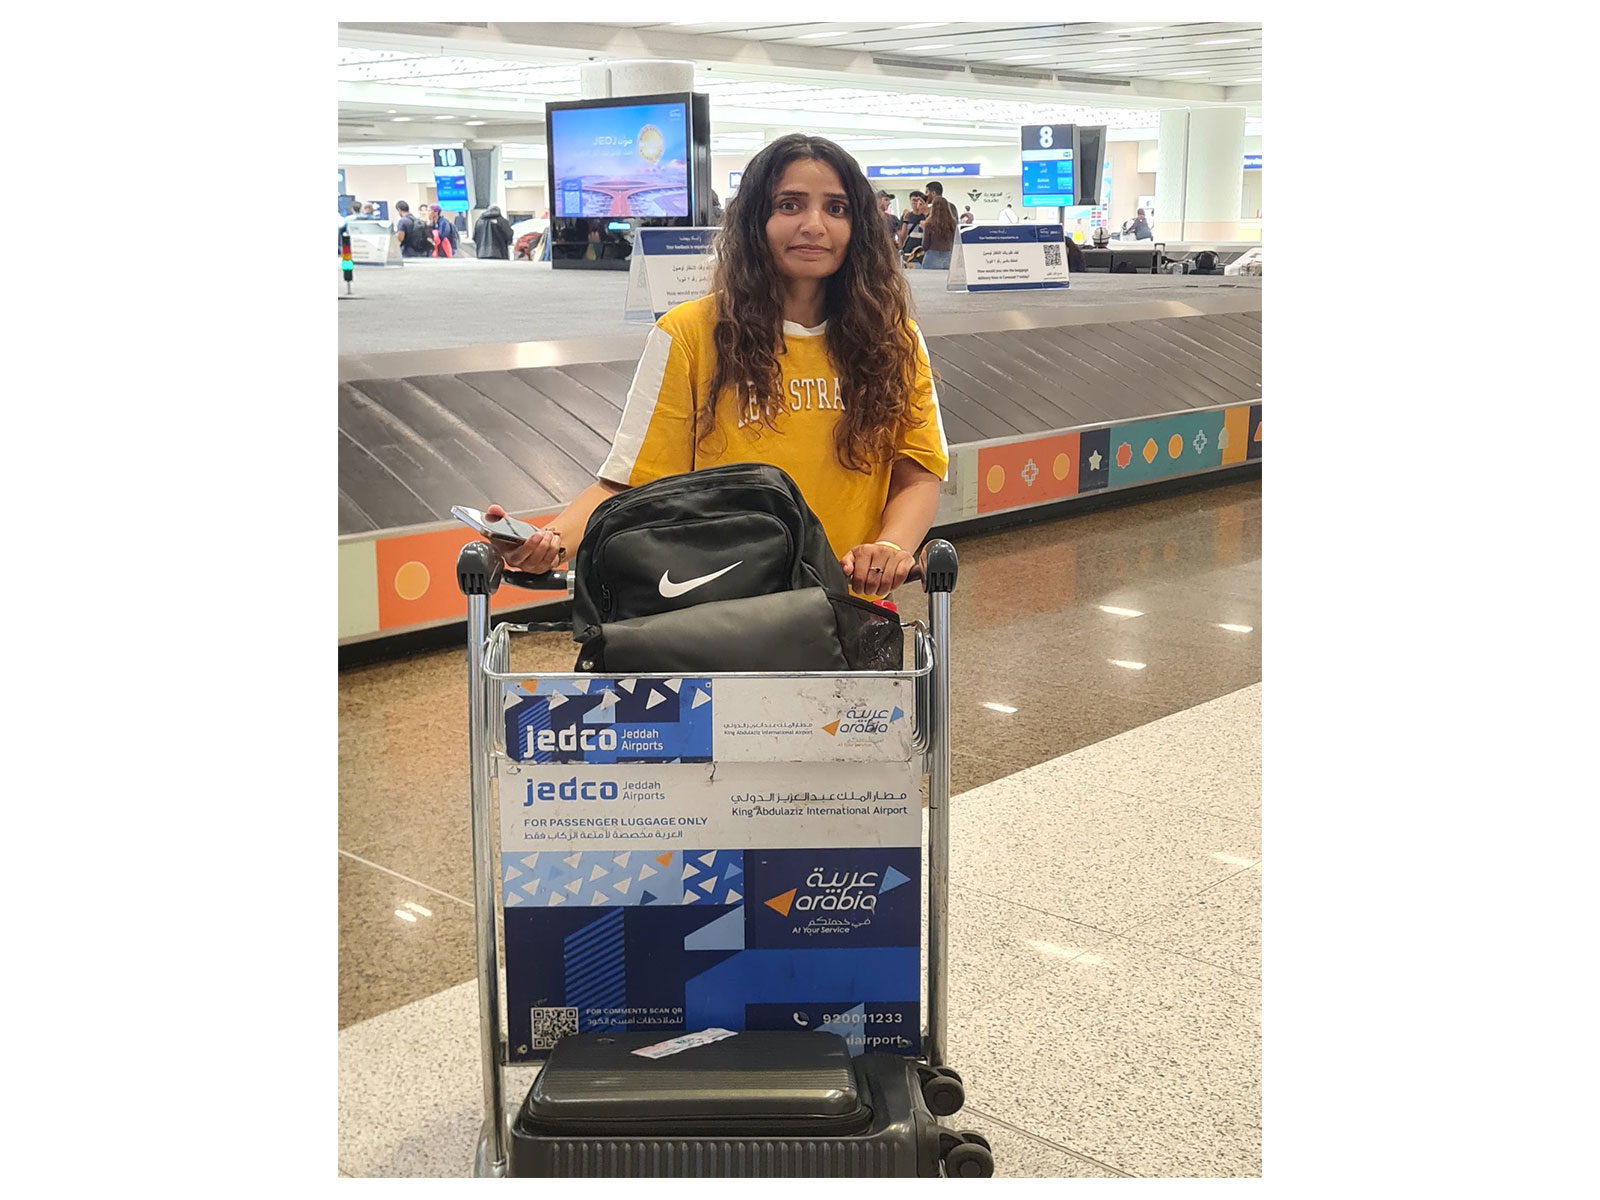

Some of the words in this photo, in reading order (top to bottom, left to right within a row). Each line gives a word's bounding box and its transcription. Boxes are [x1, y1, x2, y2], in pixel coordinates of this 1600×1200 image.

[1040, 126, 1053, 148] 8
[439, 149, 457, 166] 10
[790, 377, 846, 411] STRA
[621, 729, 659, 739] Jeddah
[523, 722, 618, 758] jedco
[621, 740, 663, 752] Airports
[622, 781, 661, 790] Jeddah
[523, 777, 618, 807] jedco
[623, 791, 665, 801] Airports
[837, 791, 871, 803] الملك
[873, 791, 907, 802] مطار
[731, 792, 774, 804] الدولي
[732, 807, 754, 817] King
[756, 806, 803, 816] Abdulaziz
[807, 806, 870, 815] International
[873, 806, 907, 816] Airport
[524, 818, 547, 827] FOR
[549, 818, 619, 827] PASSENGER
[621, 817, 675, 826] LUGGAGE
[678, 817, 708, 826] ONLY
[524, 831, 546, 840] فقط
[548, 830, 578, 841] الركاب
[580, 830, 611, 839] لأمتعة
[612, 830, 653, 839] مخصصة
[655, 830, 683, 840] العربة
[806, 867, 879, 893] عربية
[795, 888, 877, 911] arabia
[808, 916, 851, 927] خدمتكم
[852, 918, 871, 928] في
[803, 926, 820, 934] Your
[671, 1007, 683, 1015] QR
[588, 1017, 609, 1026] الكود
[636, 1016, 683, 1025] للملاحظات
[823, 1013, 903, 1025] 920011233
